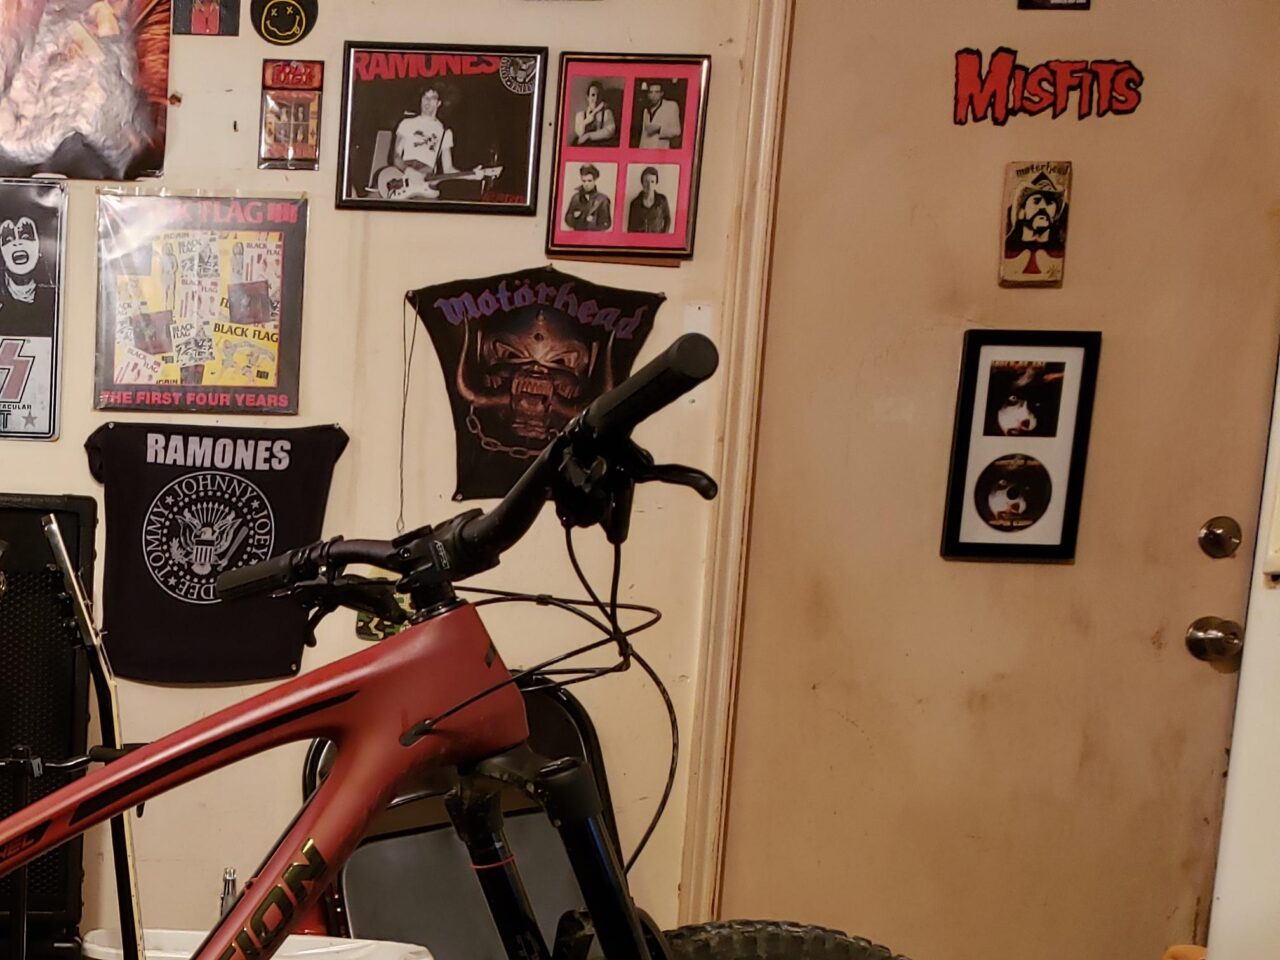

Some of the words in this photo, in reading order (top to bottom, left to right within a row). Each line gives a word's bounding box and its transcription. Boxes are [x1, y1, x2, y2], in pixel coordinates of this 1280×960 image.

[214, 323, 248, 338] BLACK
[252, 329, 279, 343] FLAG
[100, 391, 132, 405] THE
[136, 391, 181, 405] FIRST
[187, 392, 231, 406] FOUR
[235, 394, 289, 407] YEARS
[146, 433, 291, 470] RAMONES
[146, 502, 169, 582] TOMMY
[173, 475, 257, 503] JOHNNY
[252, 510, 271, 561] JOEY
